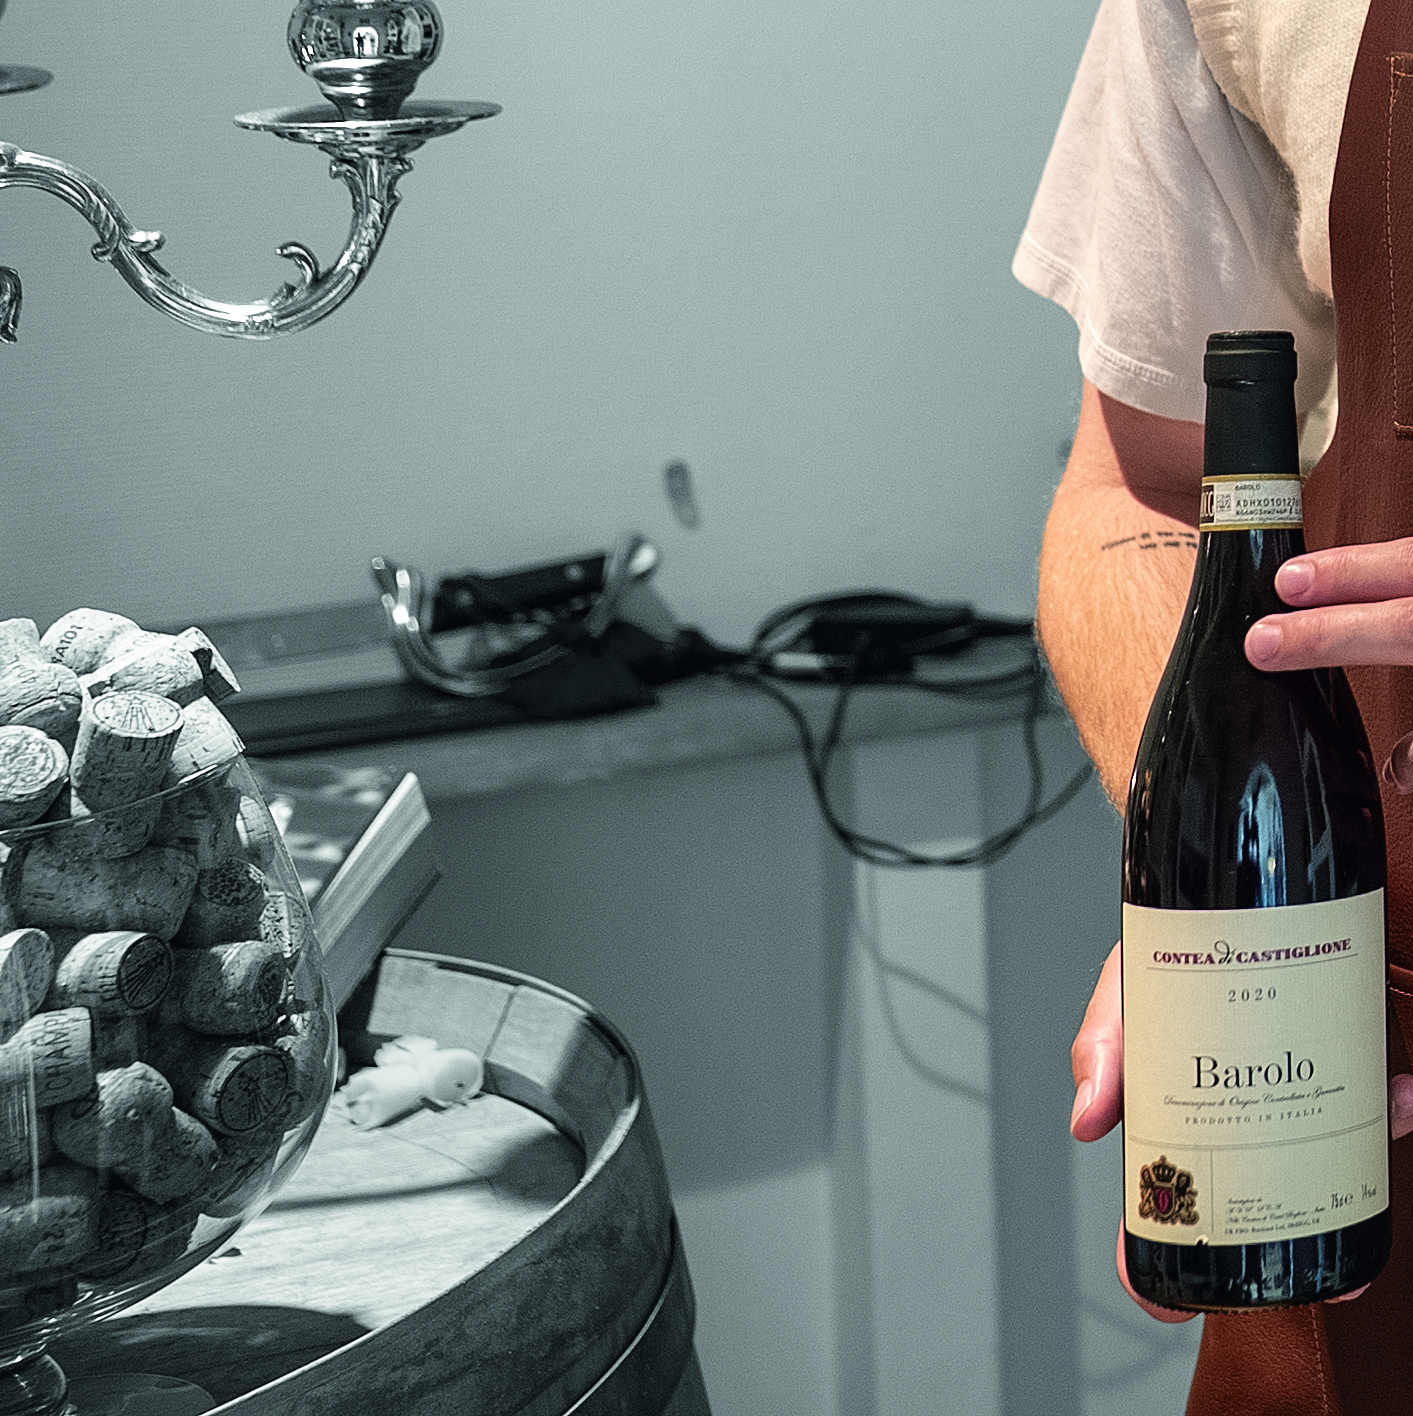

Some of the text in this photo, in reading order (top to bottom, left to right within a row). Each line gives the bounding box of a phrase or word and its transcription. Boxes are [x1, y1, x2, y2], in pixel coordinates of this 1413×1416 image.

[1153, 938, 1351, 965] CONTEA di CASTIGLIONE
[1228, 987, 1277, 1002] 2020
[1192, 1051, 1315, 1089] Barolo
[1185, 1107, 1323, 1125] PRODOTTO IN ITALIA
